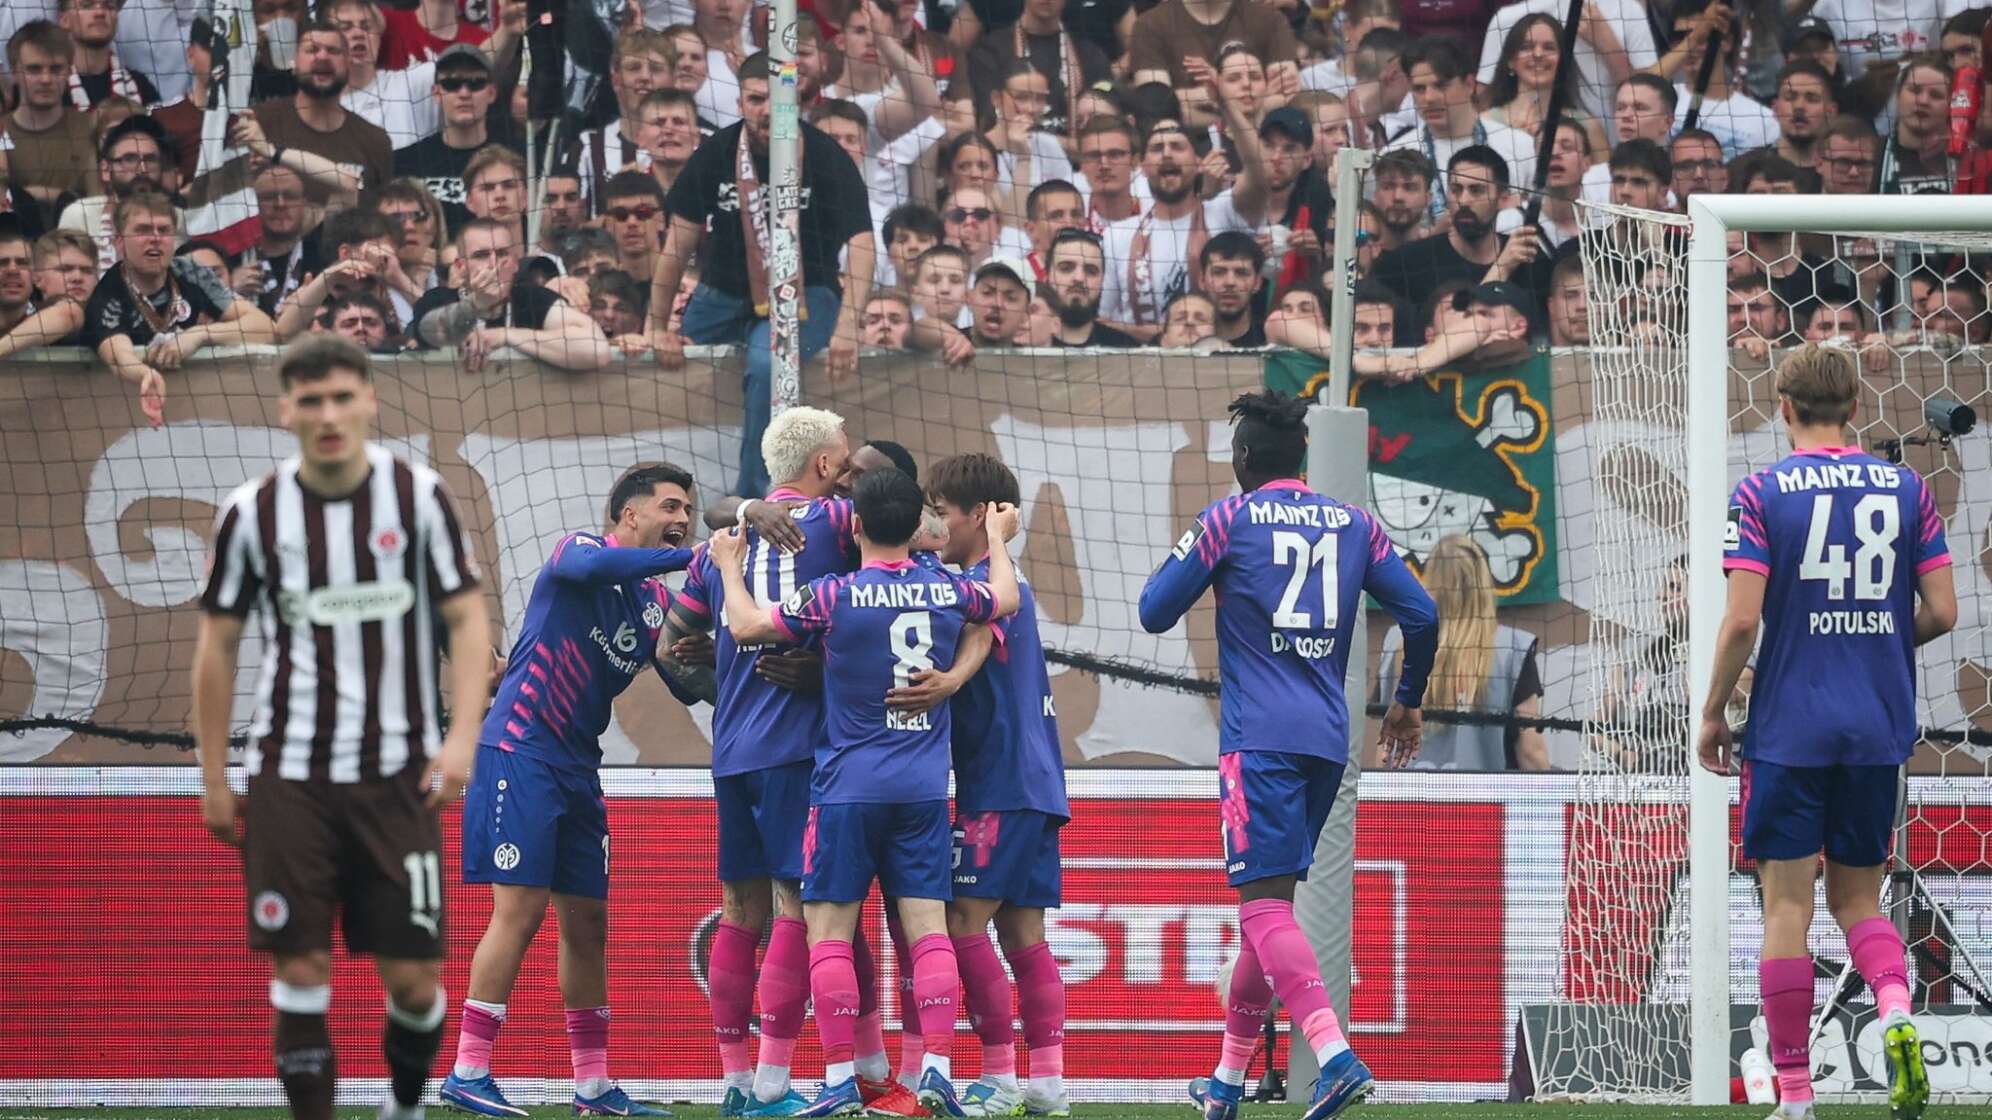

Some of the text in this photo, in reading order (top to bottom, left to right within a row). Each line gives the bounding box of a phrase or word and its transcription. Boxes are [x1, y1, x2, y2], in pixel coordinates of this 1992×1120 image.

[1775, 465, 1900, 493] MAINZ 05
[1249, 501, 1351, 529] MAINZ 05
[1799, 494, 1900, 600] 48
[1272, 531, 1338, 629] 21
[851, 583, 957, 608] MAINZ 05
[1809, 611, 1895, 635] POTULSKI
[889, 611, 934, 702] 8
[404, 850, 441, 911] 11
[954, 875, 977, 884] JAKO
[919, 997, 951, 1009] JAKO
[714, 1026, 741, 1035] AKO
